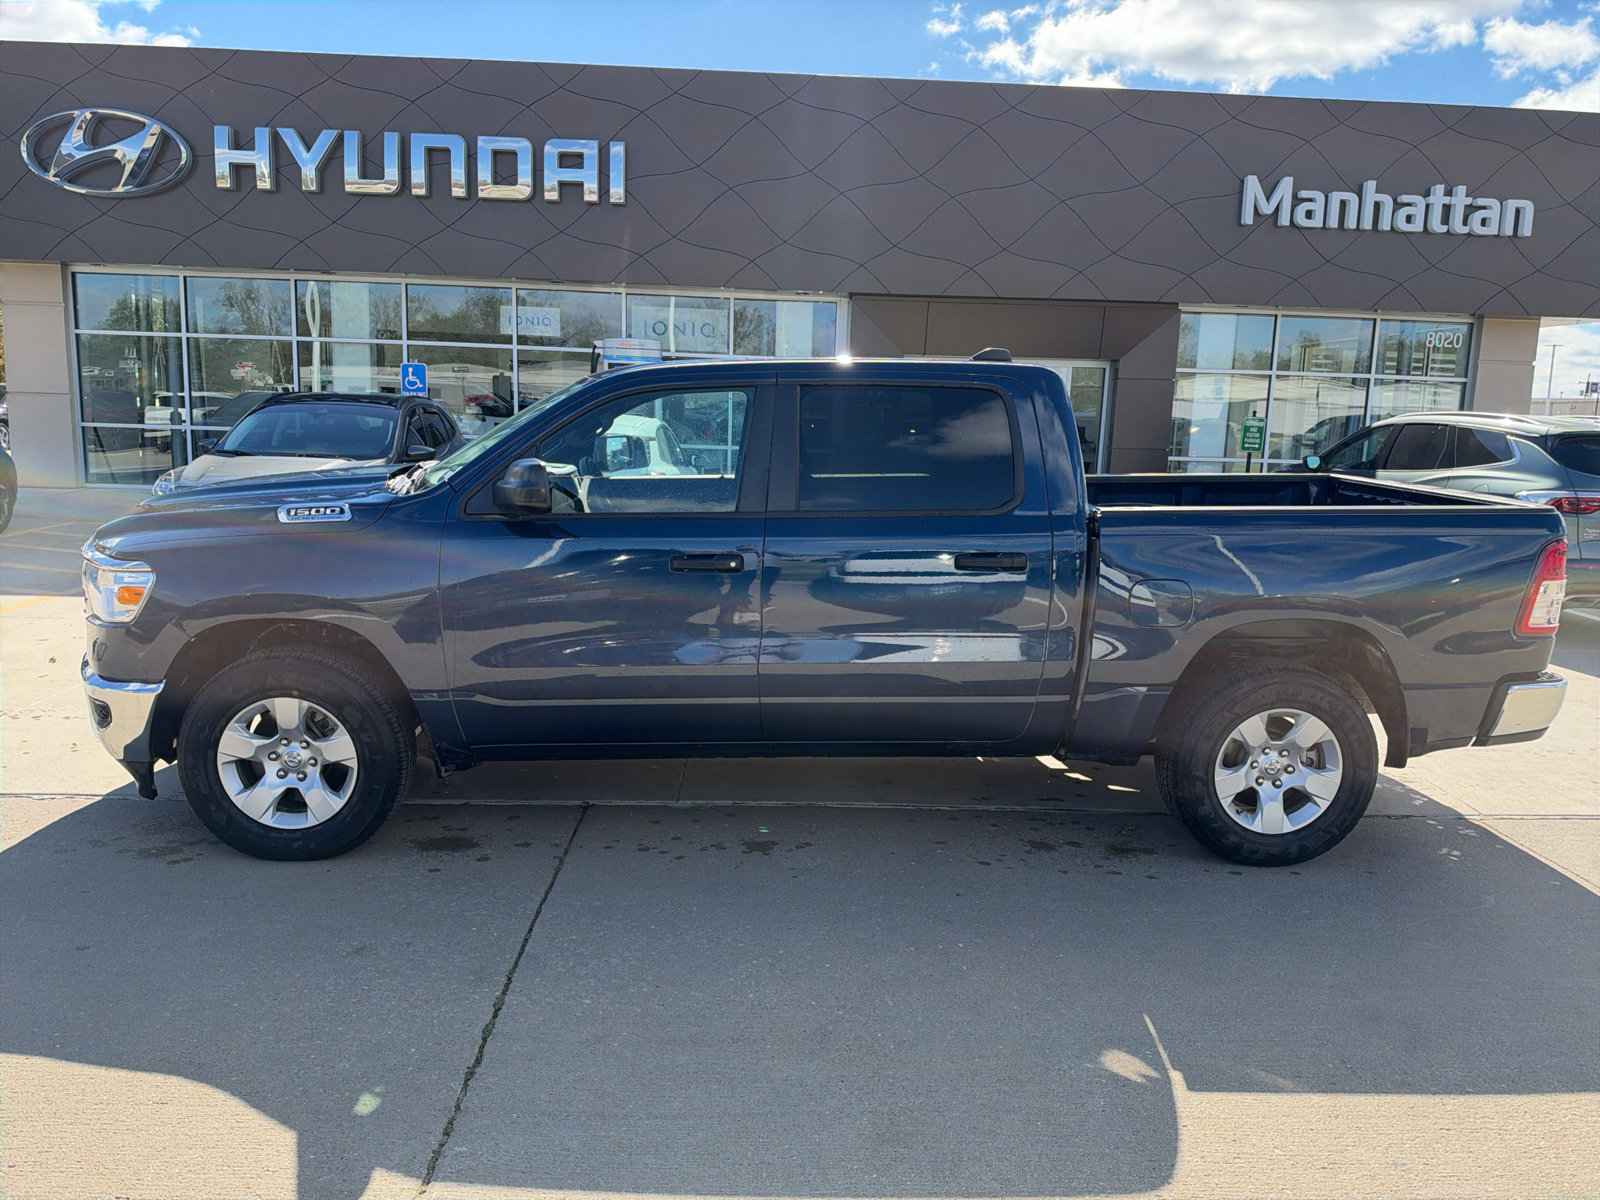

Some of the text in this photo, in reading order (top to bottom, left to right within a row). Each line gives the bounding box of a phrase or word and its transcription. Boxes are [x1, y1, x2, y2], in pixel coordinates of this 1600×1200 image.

[213, 125, 626, 205] HYUNDAI
[1241, 175, 1534, 237] Manhattan
[508, 314, 552, 328] IONIQ
[643, 319, 716, 339] IONIQ
[1426, 331, 1463, 348] 8020
[290, 507, 341, 516] 1500
